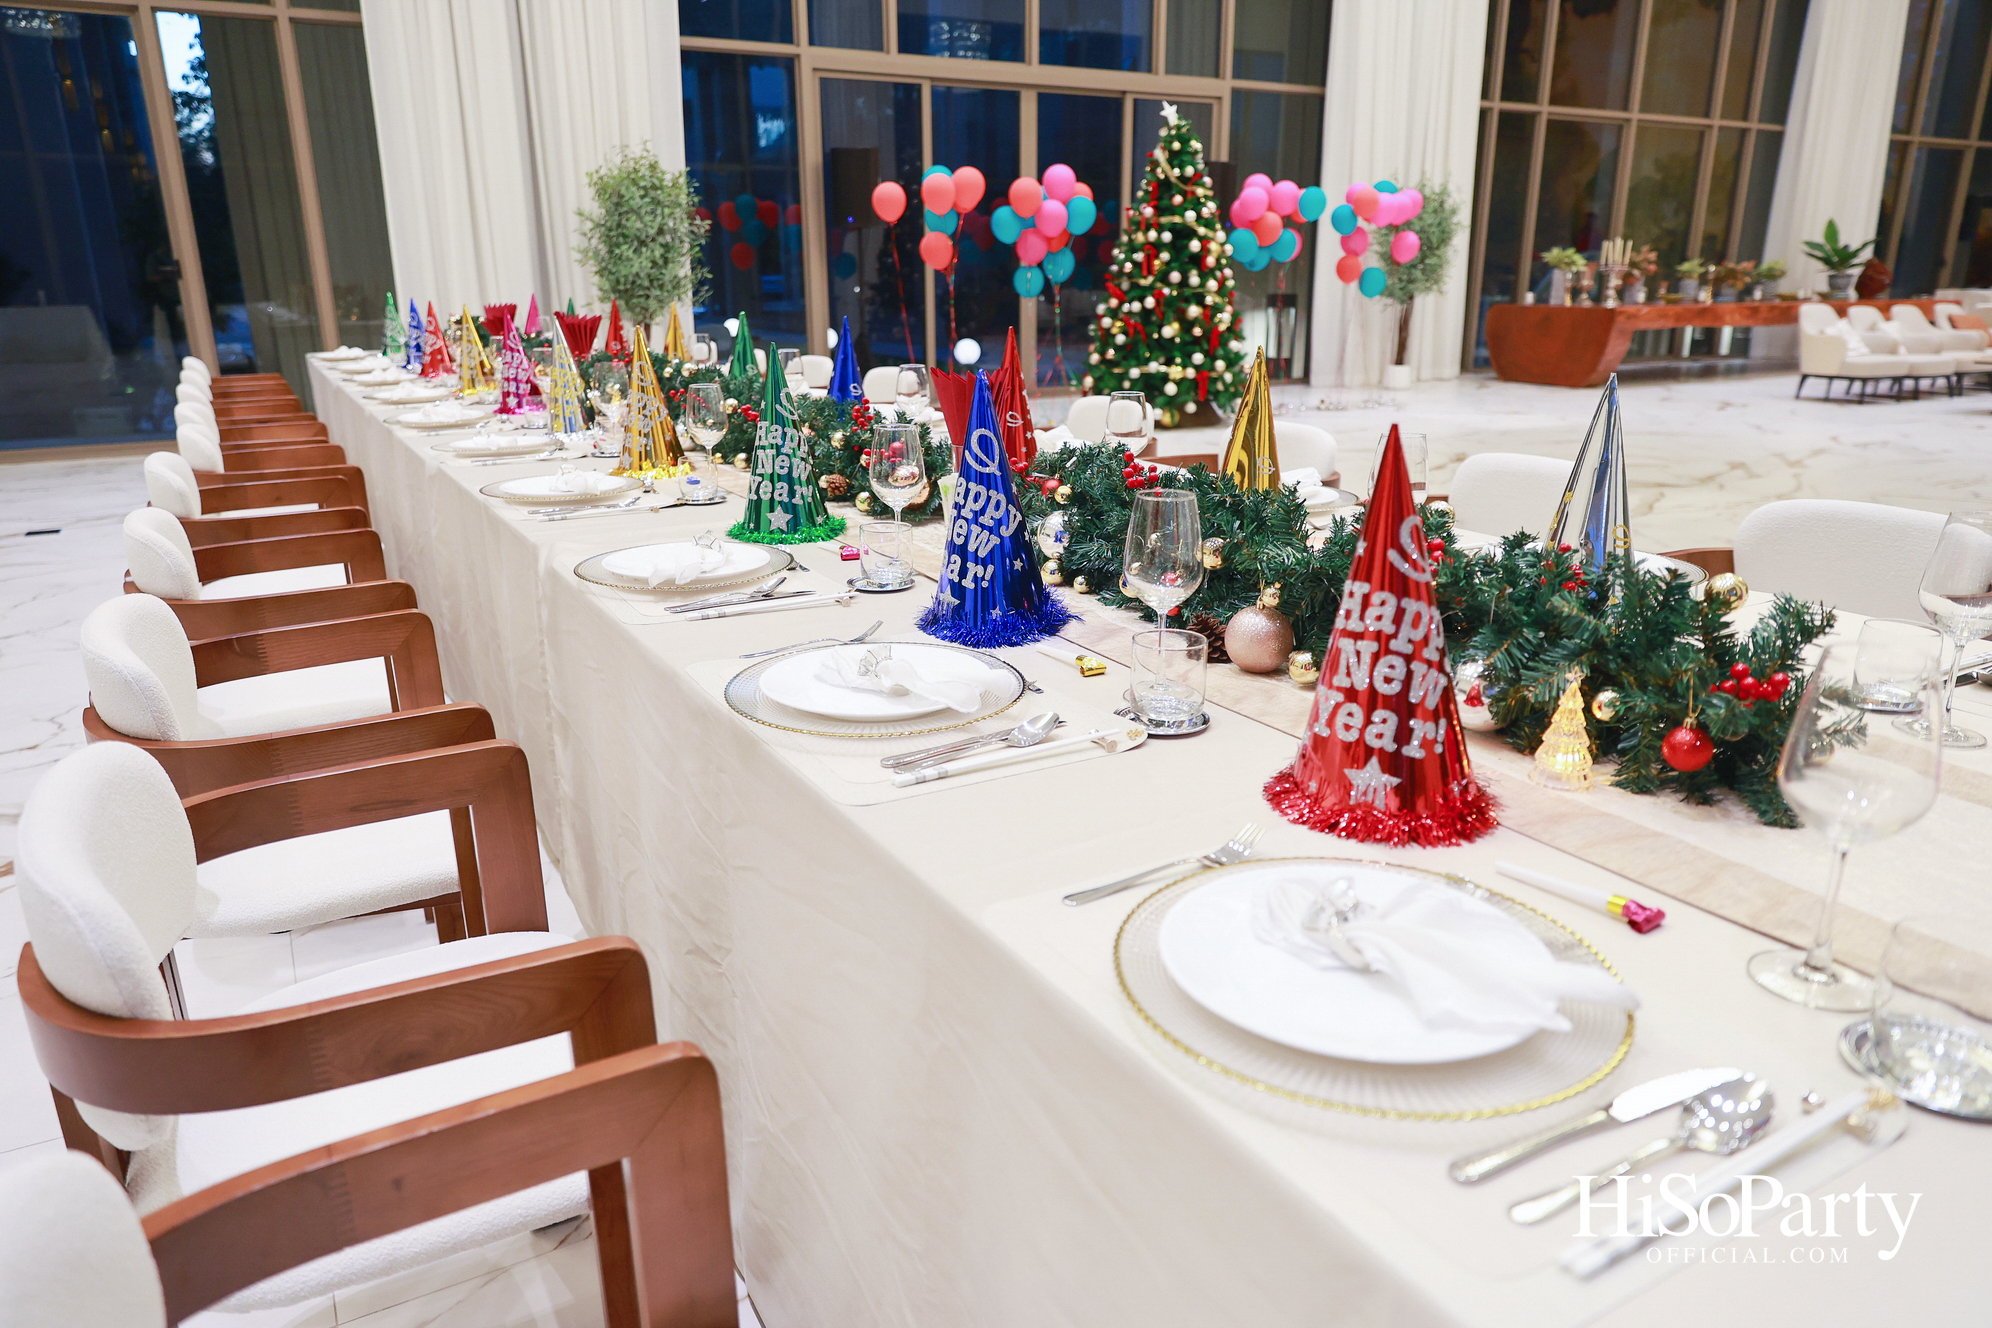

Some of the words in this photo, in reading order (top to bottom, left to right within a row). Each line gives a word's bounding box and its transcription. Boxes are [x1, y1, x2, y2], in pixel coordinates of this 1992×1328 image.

[627, 389, 669, 422] appy
[627, 412, 656, 433] ew
[755, 421, 813, 464] Happ
[756, 449, 812, 481] New
[749, 475, 813, 505] Year!
[954, 477, 1023, 537] appy
[944, 552, 995, 590] ar!
[1335, 579, 1450, 672] Happ
[1332, 636, 1448, 711] New
[1313, 685, 1448, 759] Year!
